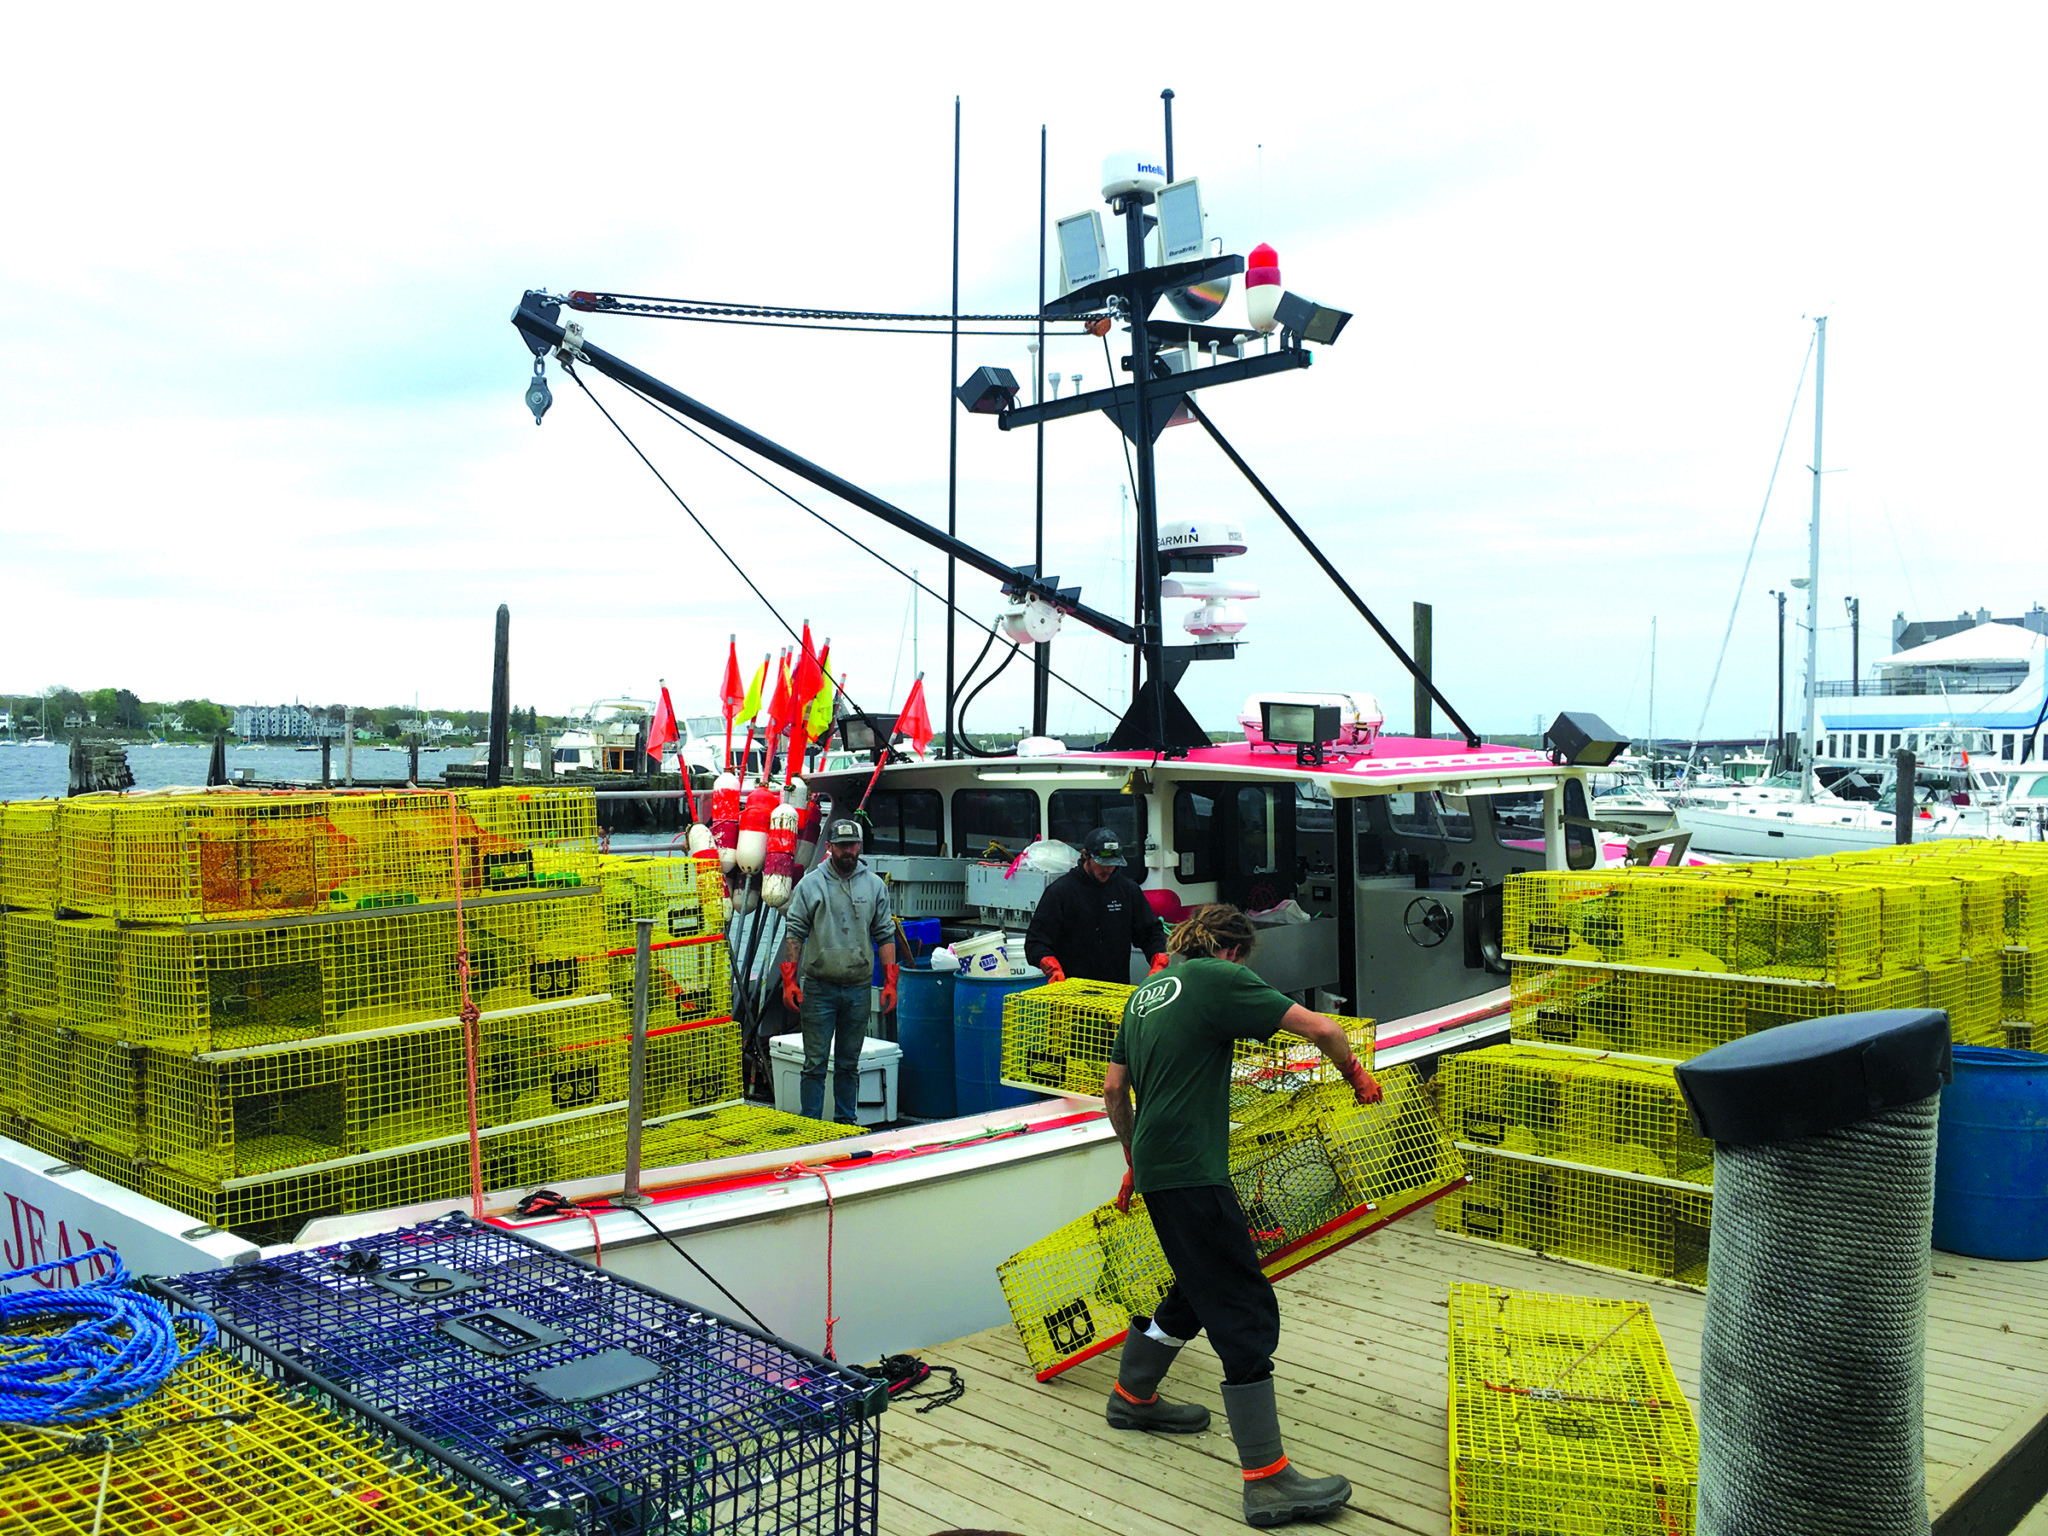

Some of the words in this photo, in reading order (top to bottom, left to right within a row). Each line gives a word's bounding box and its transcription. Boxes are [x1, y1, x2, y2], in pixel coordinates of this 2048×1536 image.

[980, 957, 997, 968] NAPA
[1138, 981, 1171, 1005] DDI
[3, 1191, 118, 1289] JEAN
